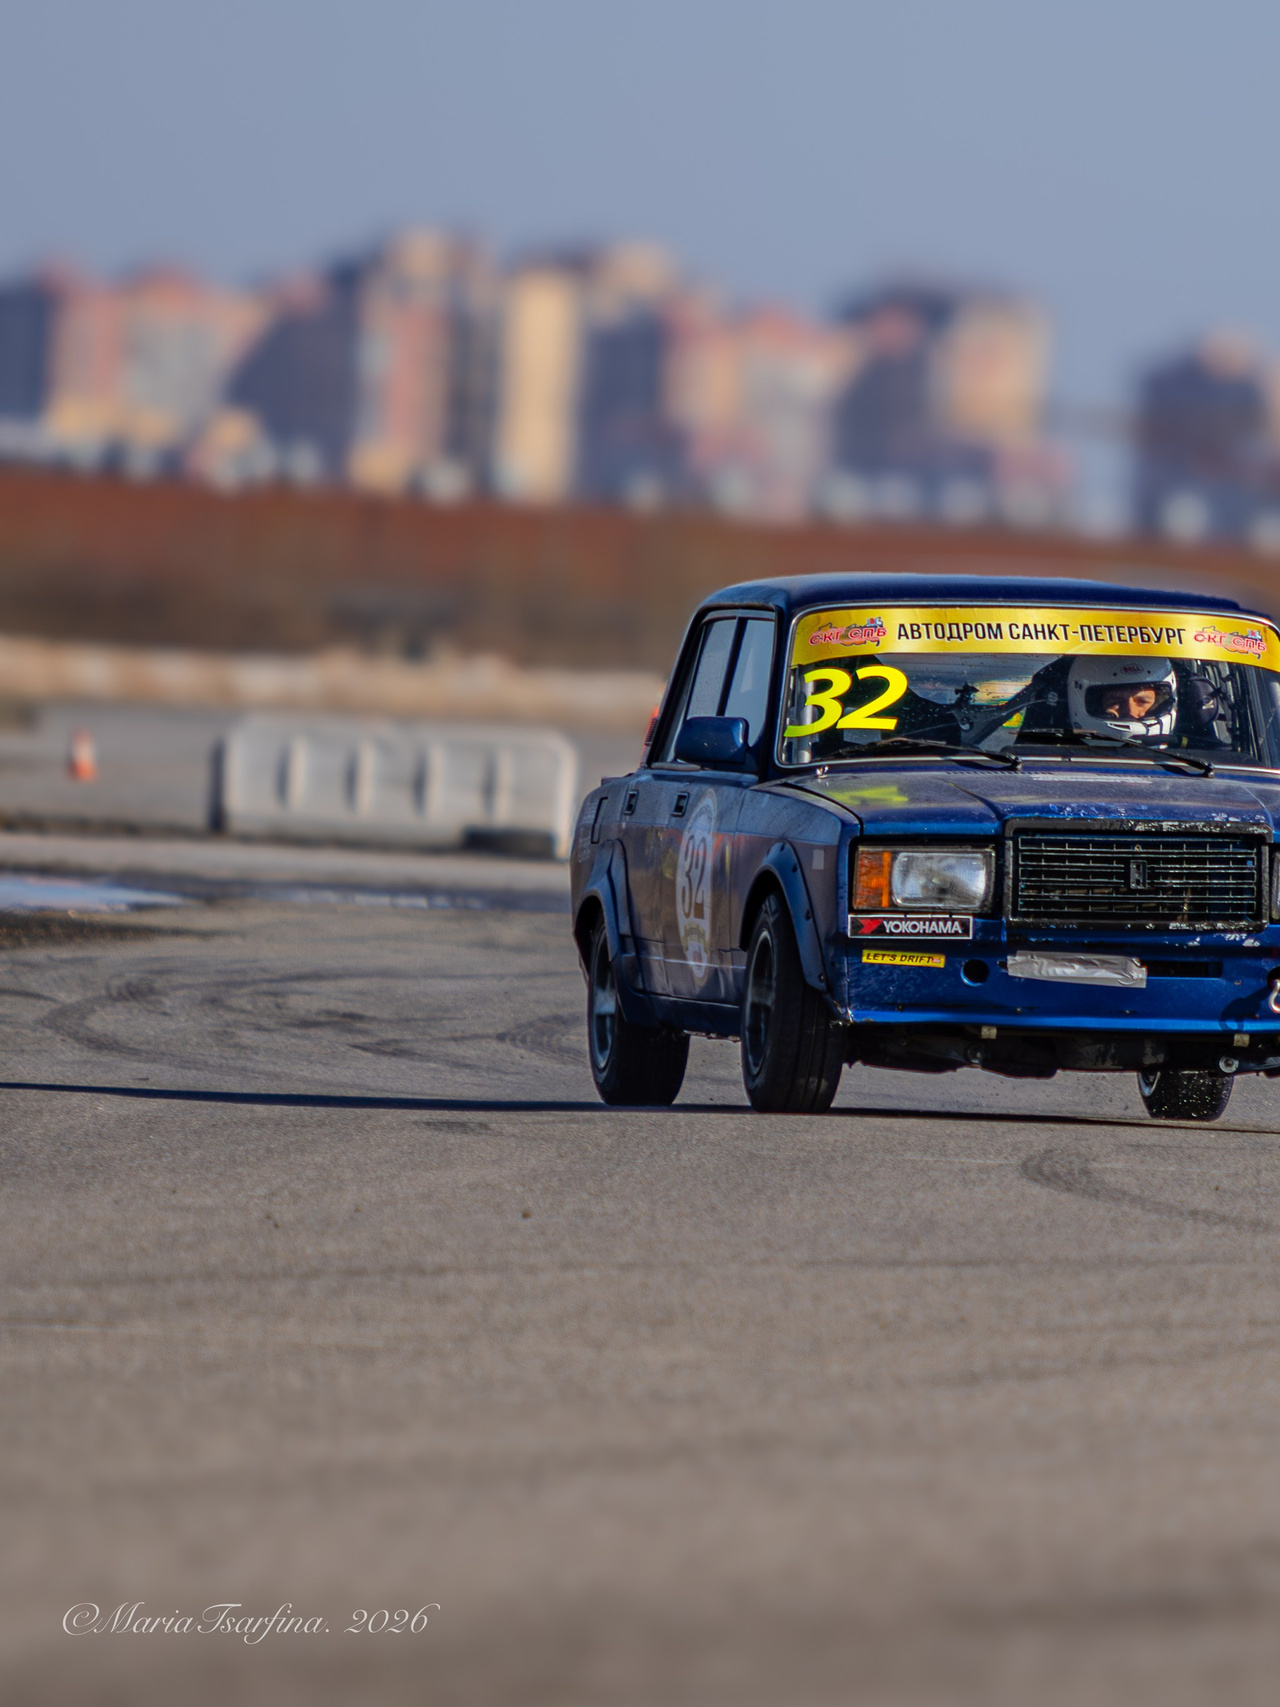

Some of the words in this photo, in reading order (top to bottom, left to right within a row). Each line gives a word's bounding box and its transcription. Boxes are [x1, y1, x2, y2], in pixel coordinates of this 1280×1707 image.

[897, 622, 1003, 641] АВТОДРОМ
[1008, 622, 1186, 645] САНКТ-ПЕТЕРБУРГ
[783, 665, 909, 737] 32
[682, 834, 707, 920] 32
[883, 920, 963, 934] YOKOHAMA
[866, 952, 896, 961] LET'S
[900, 954, 933, 964] DRIFT
